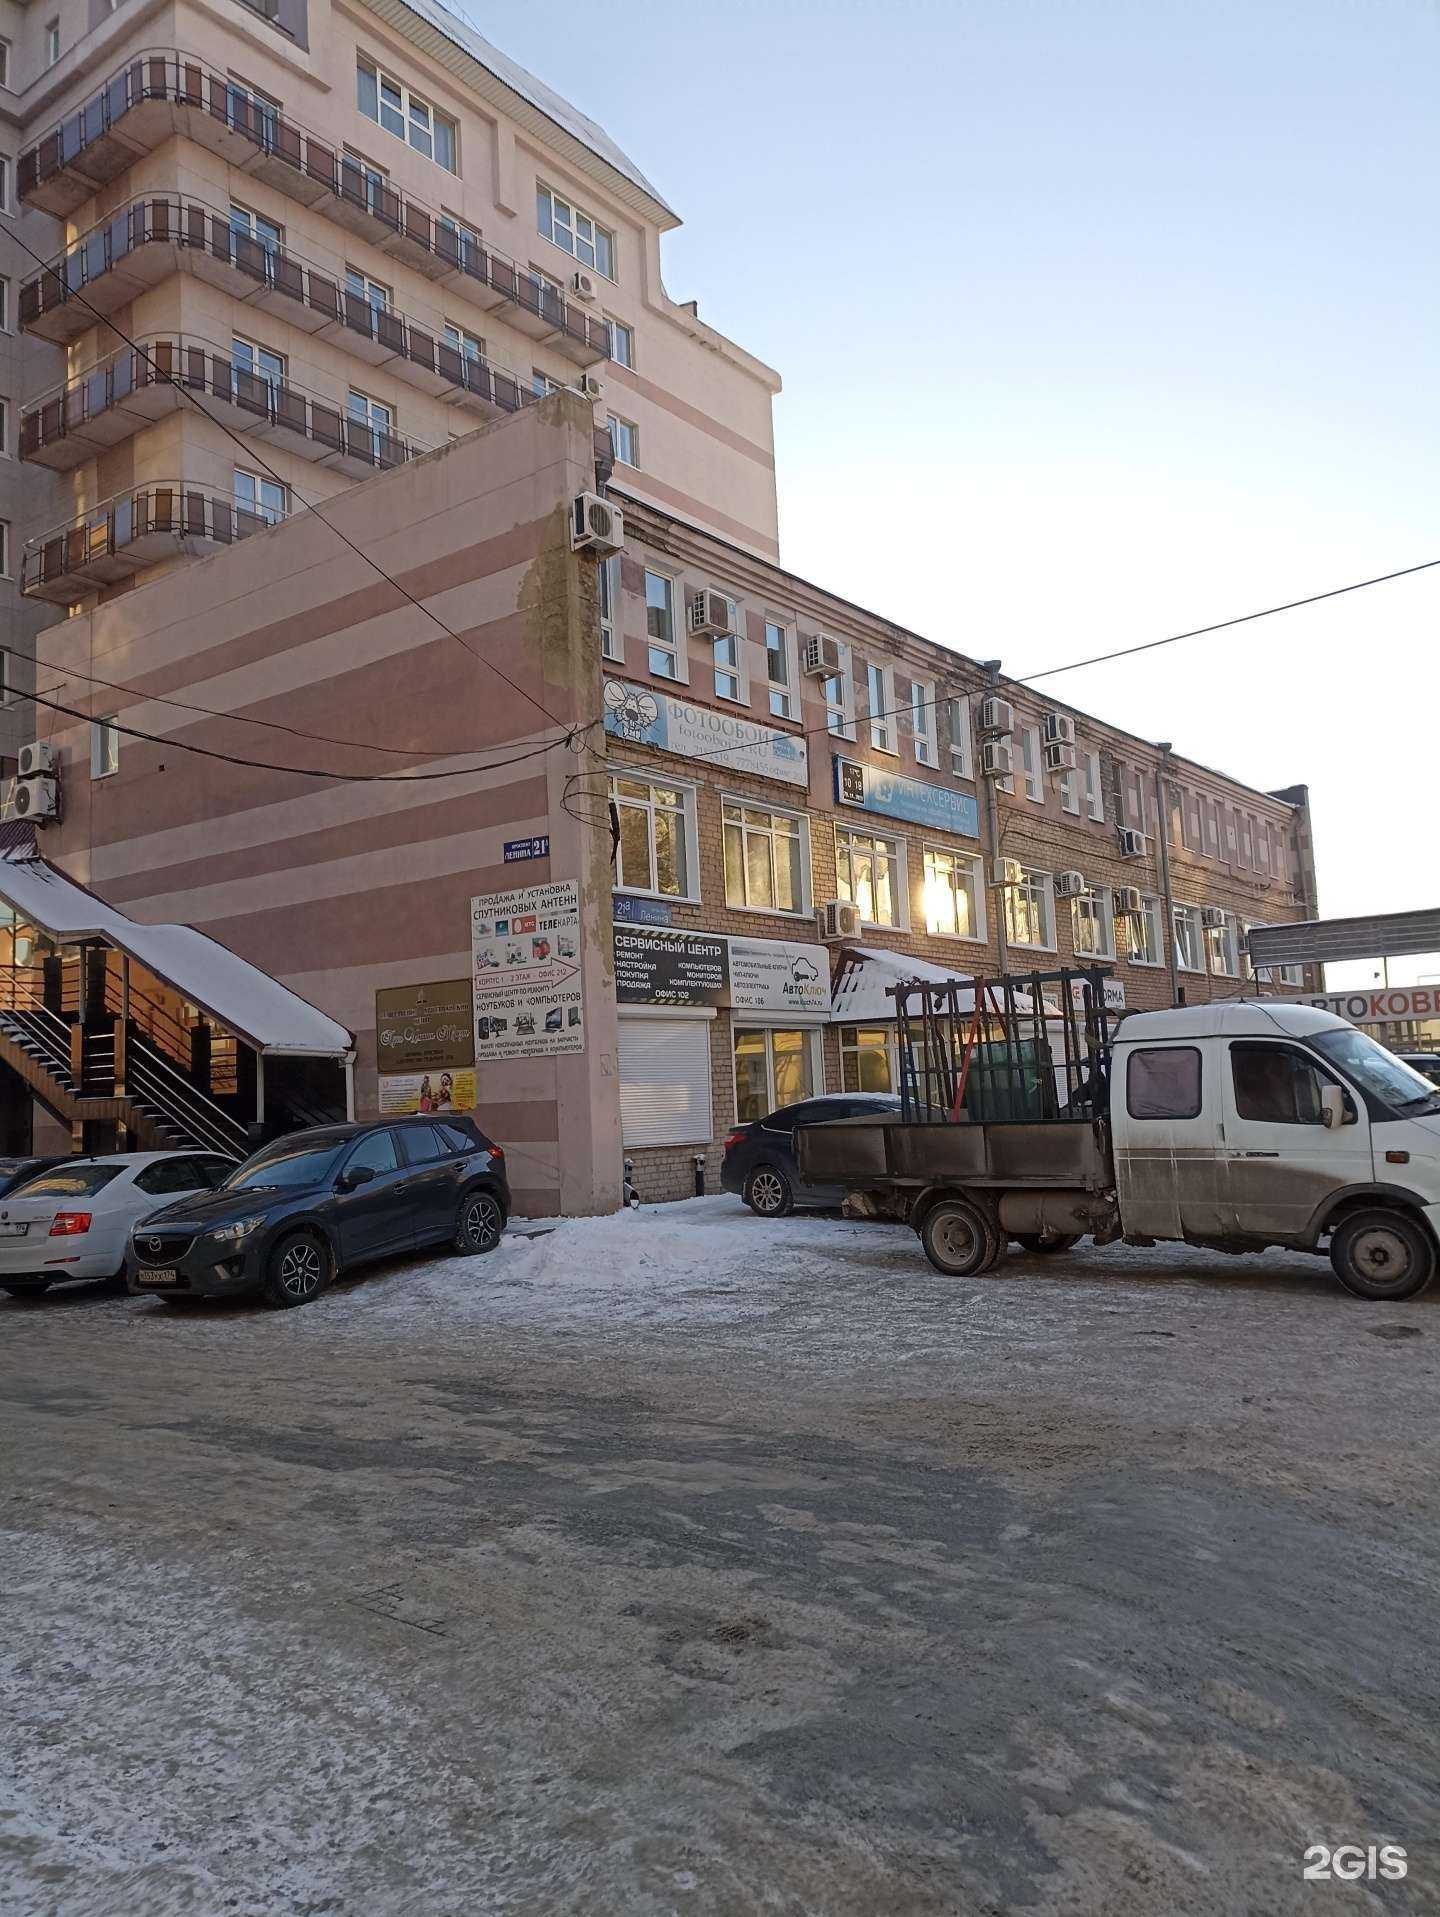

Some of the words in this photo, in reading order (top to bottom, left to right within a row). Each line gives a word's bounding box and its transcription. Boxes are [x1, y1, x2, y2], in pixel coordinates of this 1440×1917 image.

[669, 703, 769, 746] ФОТООБОИ
[479, 894, 515, 907] ПРОДАЖА
[527, 883, 571, 898] УСТАНОВКА
[473, 901, 537, 921] СПУТНИКОВЫХ
[540, 894, 577, 909] АНТЕНН
[539, 916, 577, 931] ТЕЛЕКАРТА
[614, 936, 685, 953] СЕРВИСНЫЙ
[687, 944, 721, 957] ЦЕНТР
[616, 951, 643, 960] РЕМОНТ
[616, 960, 657, 971] НАСТРОЙКА
[677, 962, 722, 972] КОМПЬЮТЕРОВ
[616, 970, 649, 980] ПОКУПКА
[616, 980, 651, 990] ПРОДАЖА
[655, 989, 677, 999] ОФИС
[678, 991, 690, 999] 102
[476, 999, 515, 1011] НОУТБУКОВ
